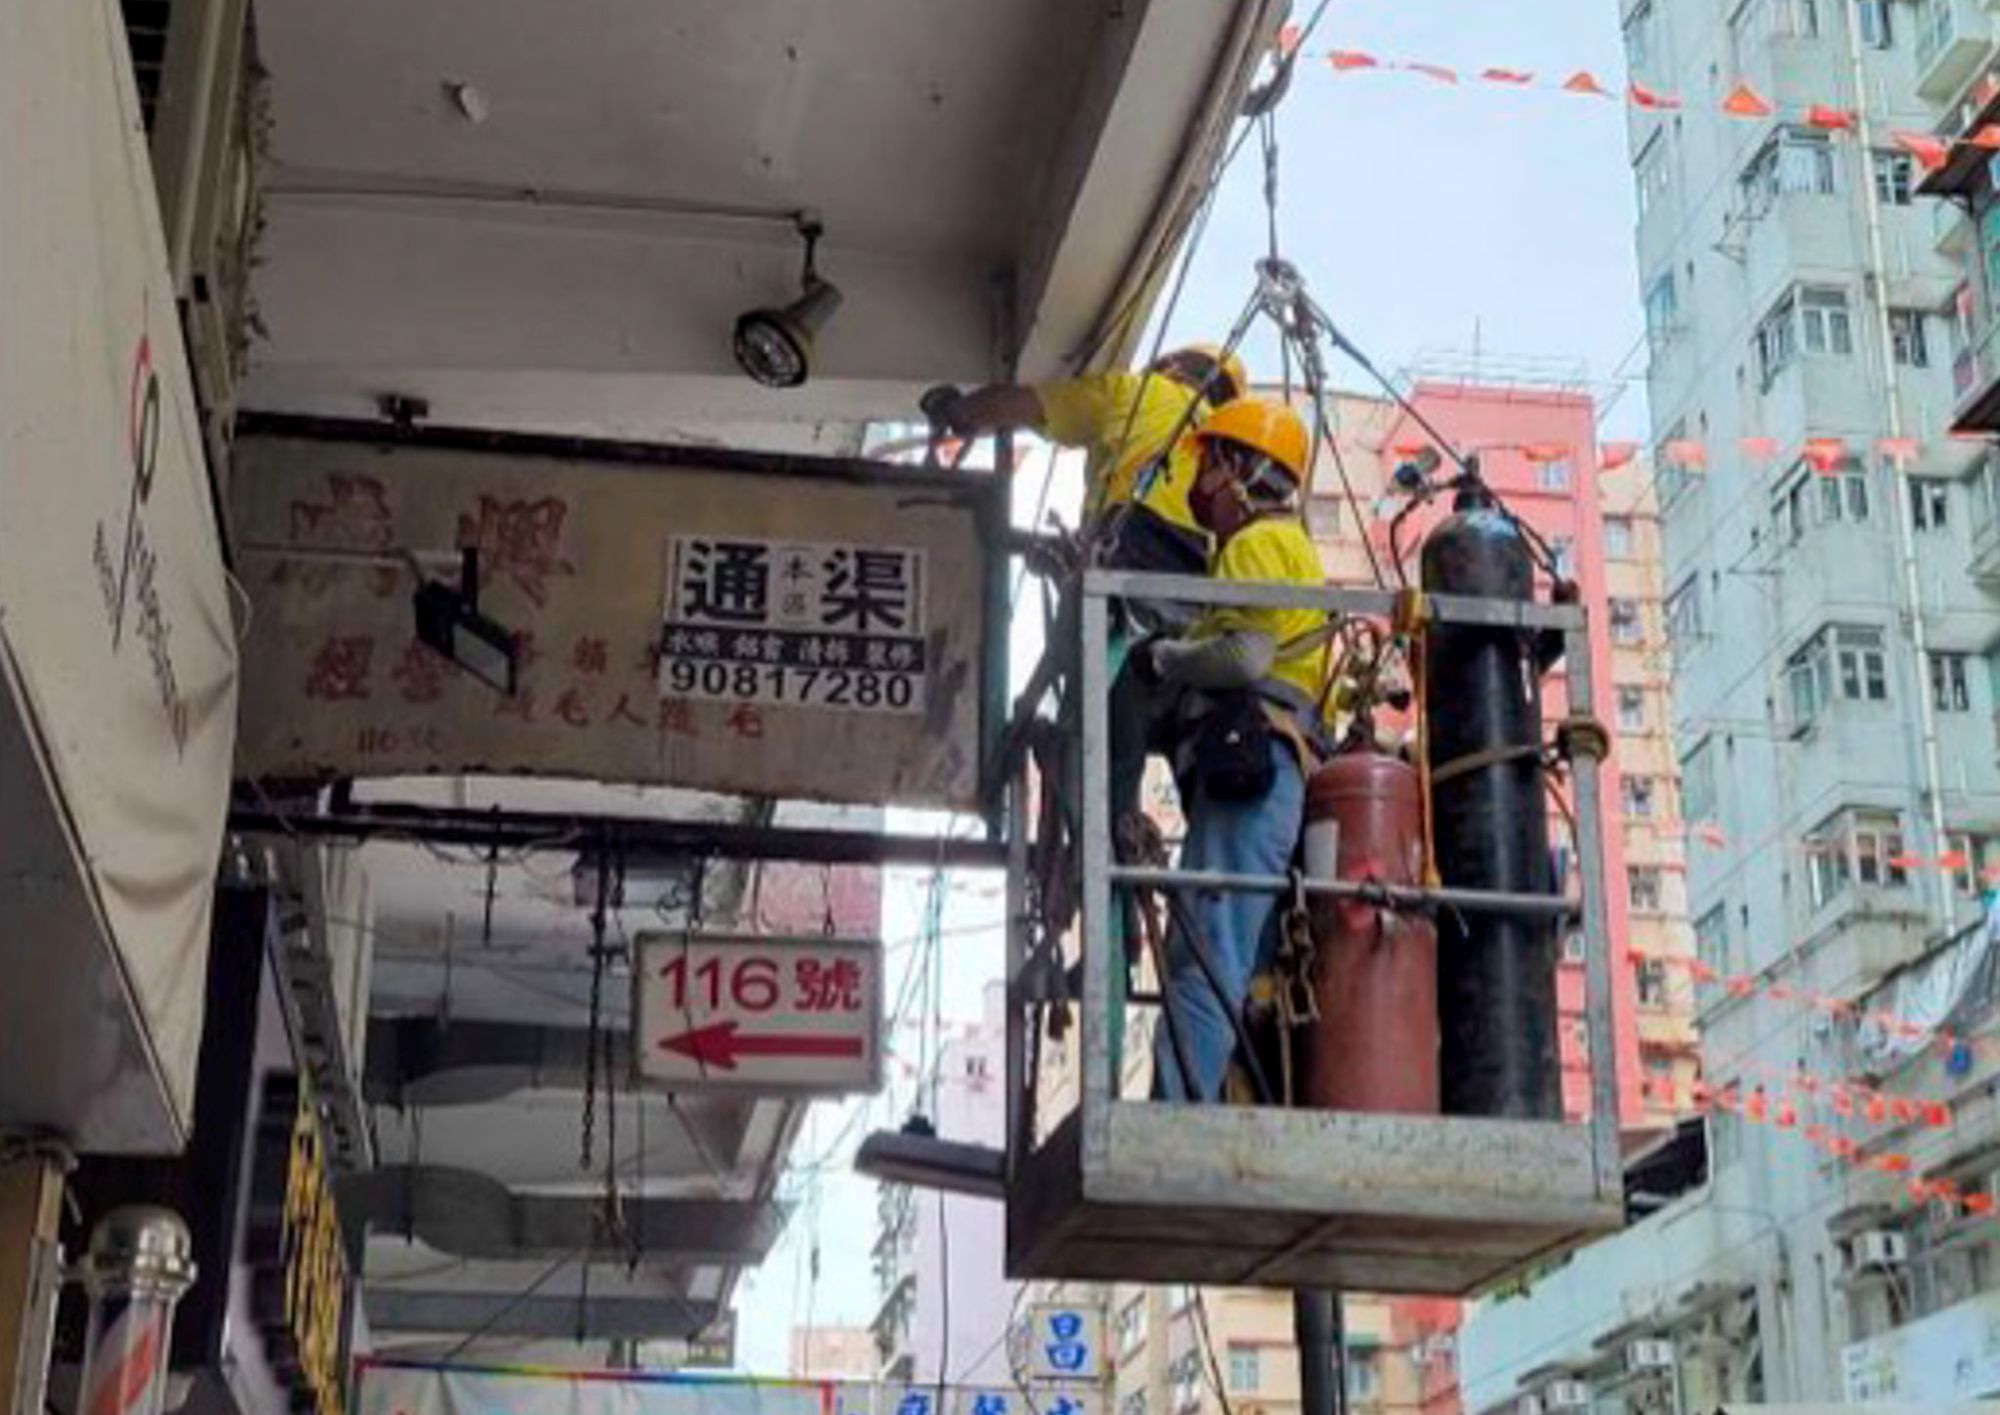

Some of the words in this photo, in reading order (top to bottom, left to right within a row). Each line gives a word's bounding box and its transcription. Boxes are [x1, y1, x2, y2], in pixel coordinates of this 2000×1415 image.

[670, 660, 913, 708] 90817280
[660, 955, 862, 1012] 116號
[1045, 1311, 1087, 1370] 昌
